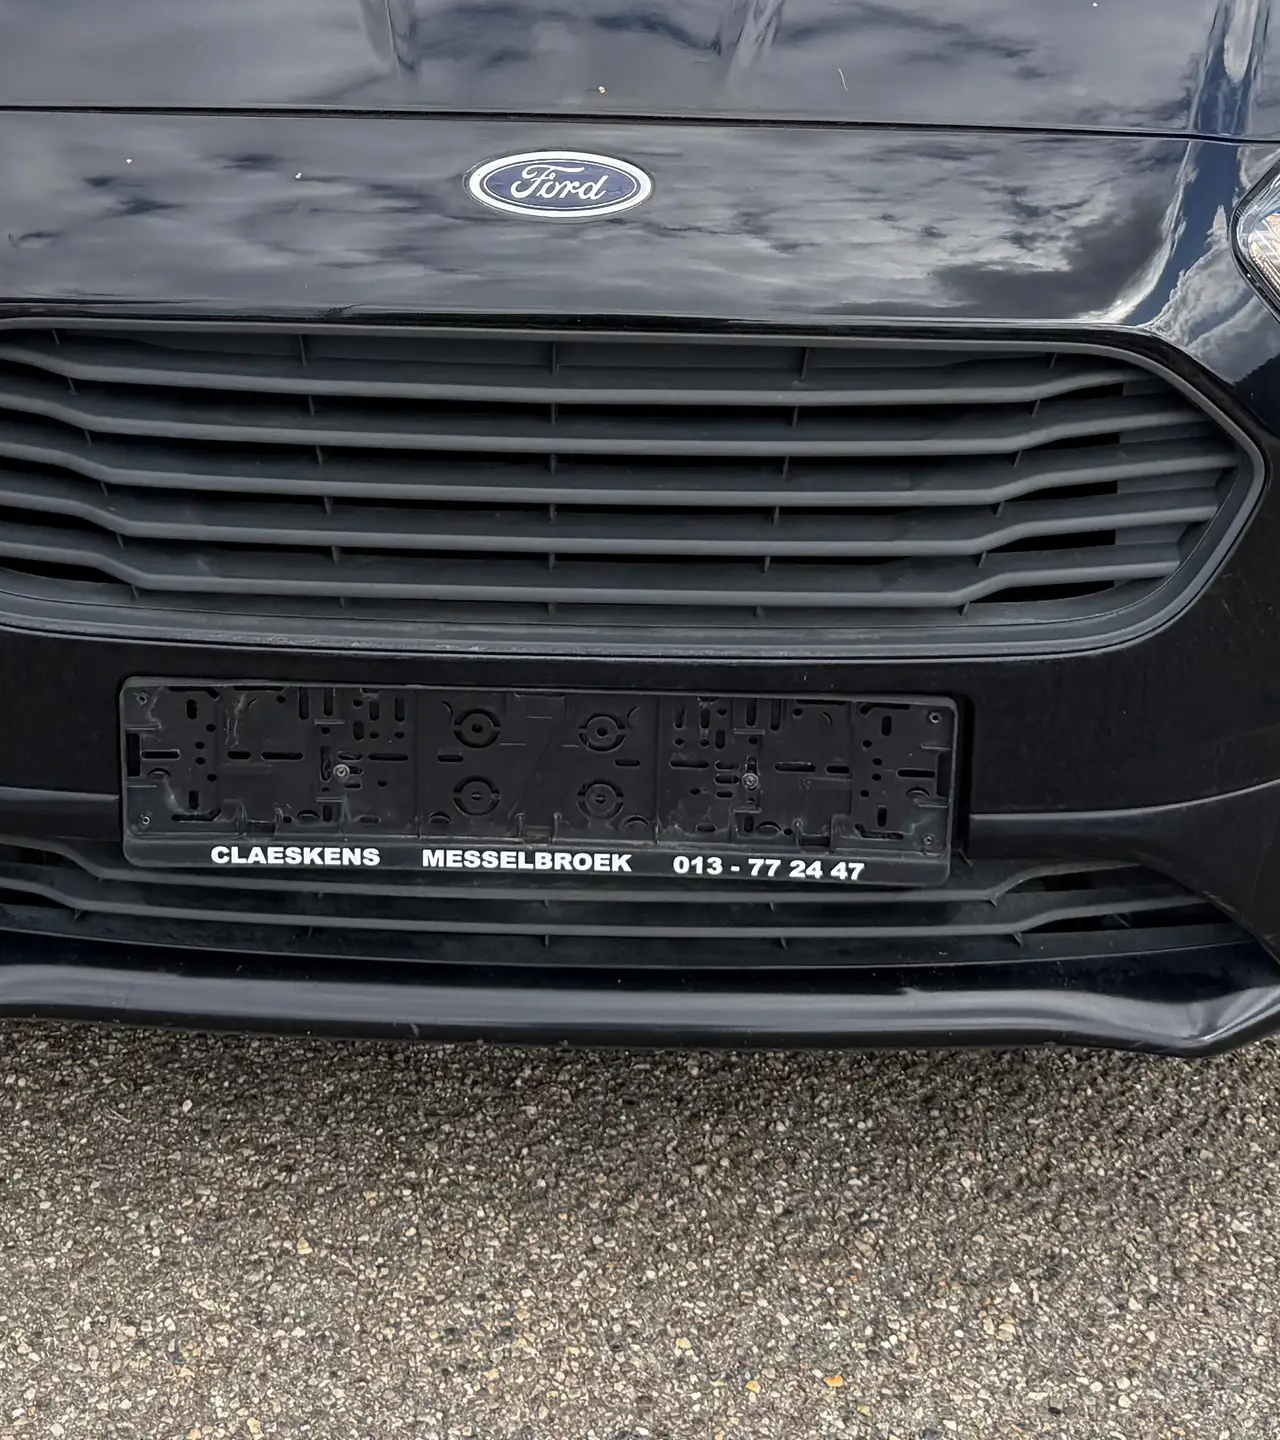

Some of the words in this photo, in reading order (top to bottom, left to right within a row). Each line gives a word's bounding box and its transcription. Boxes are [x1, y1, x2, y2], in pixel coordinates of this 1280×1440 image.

[510, 164, 609, 200] Ford
[211, 846, 381, 866] CLAESKENS
[422, 849, 632, 872] MESSELBROEK
[673, 856, 723, 875] 013
[748, 858, 781, 877] 77
[789, 860, 823, 878] 24
[830, 862, 865, 880] 47
